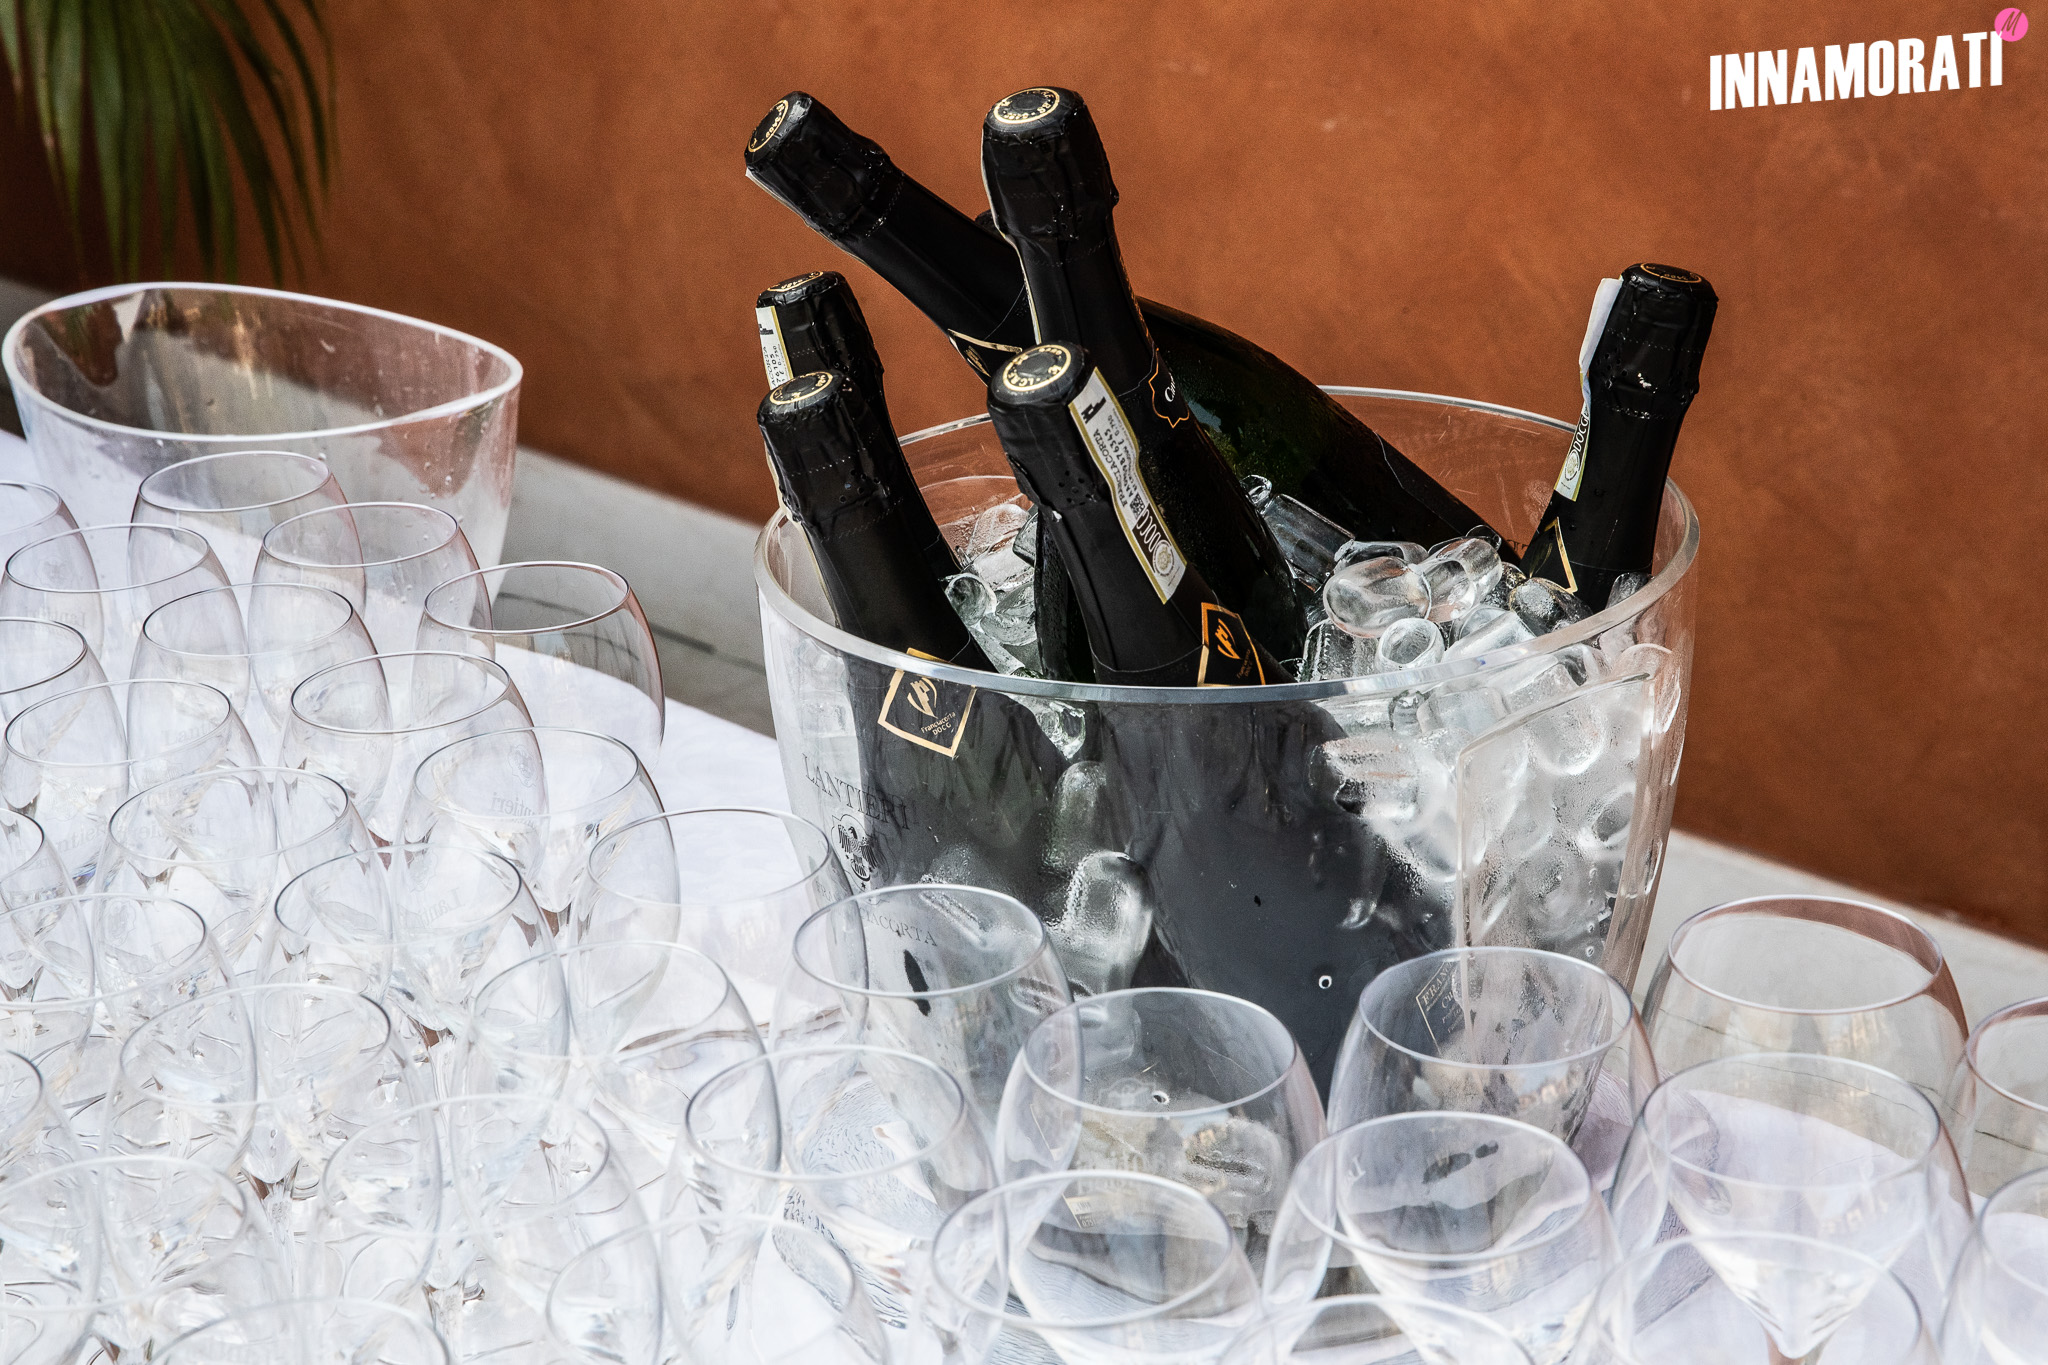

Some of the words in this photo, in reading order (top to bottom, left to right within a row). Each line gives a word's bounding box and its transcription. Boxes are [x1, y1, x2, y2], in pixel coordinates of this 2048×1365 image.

[1573, 417, 1589, 454] DOCG
[1136, 508, 1160, 553] DOCG
[920, 711, 956, 734] Franciacorta
[931, 722, 952, 736] DOCG
[802, 753, 911, 830] LANTIERI
